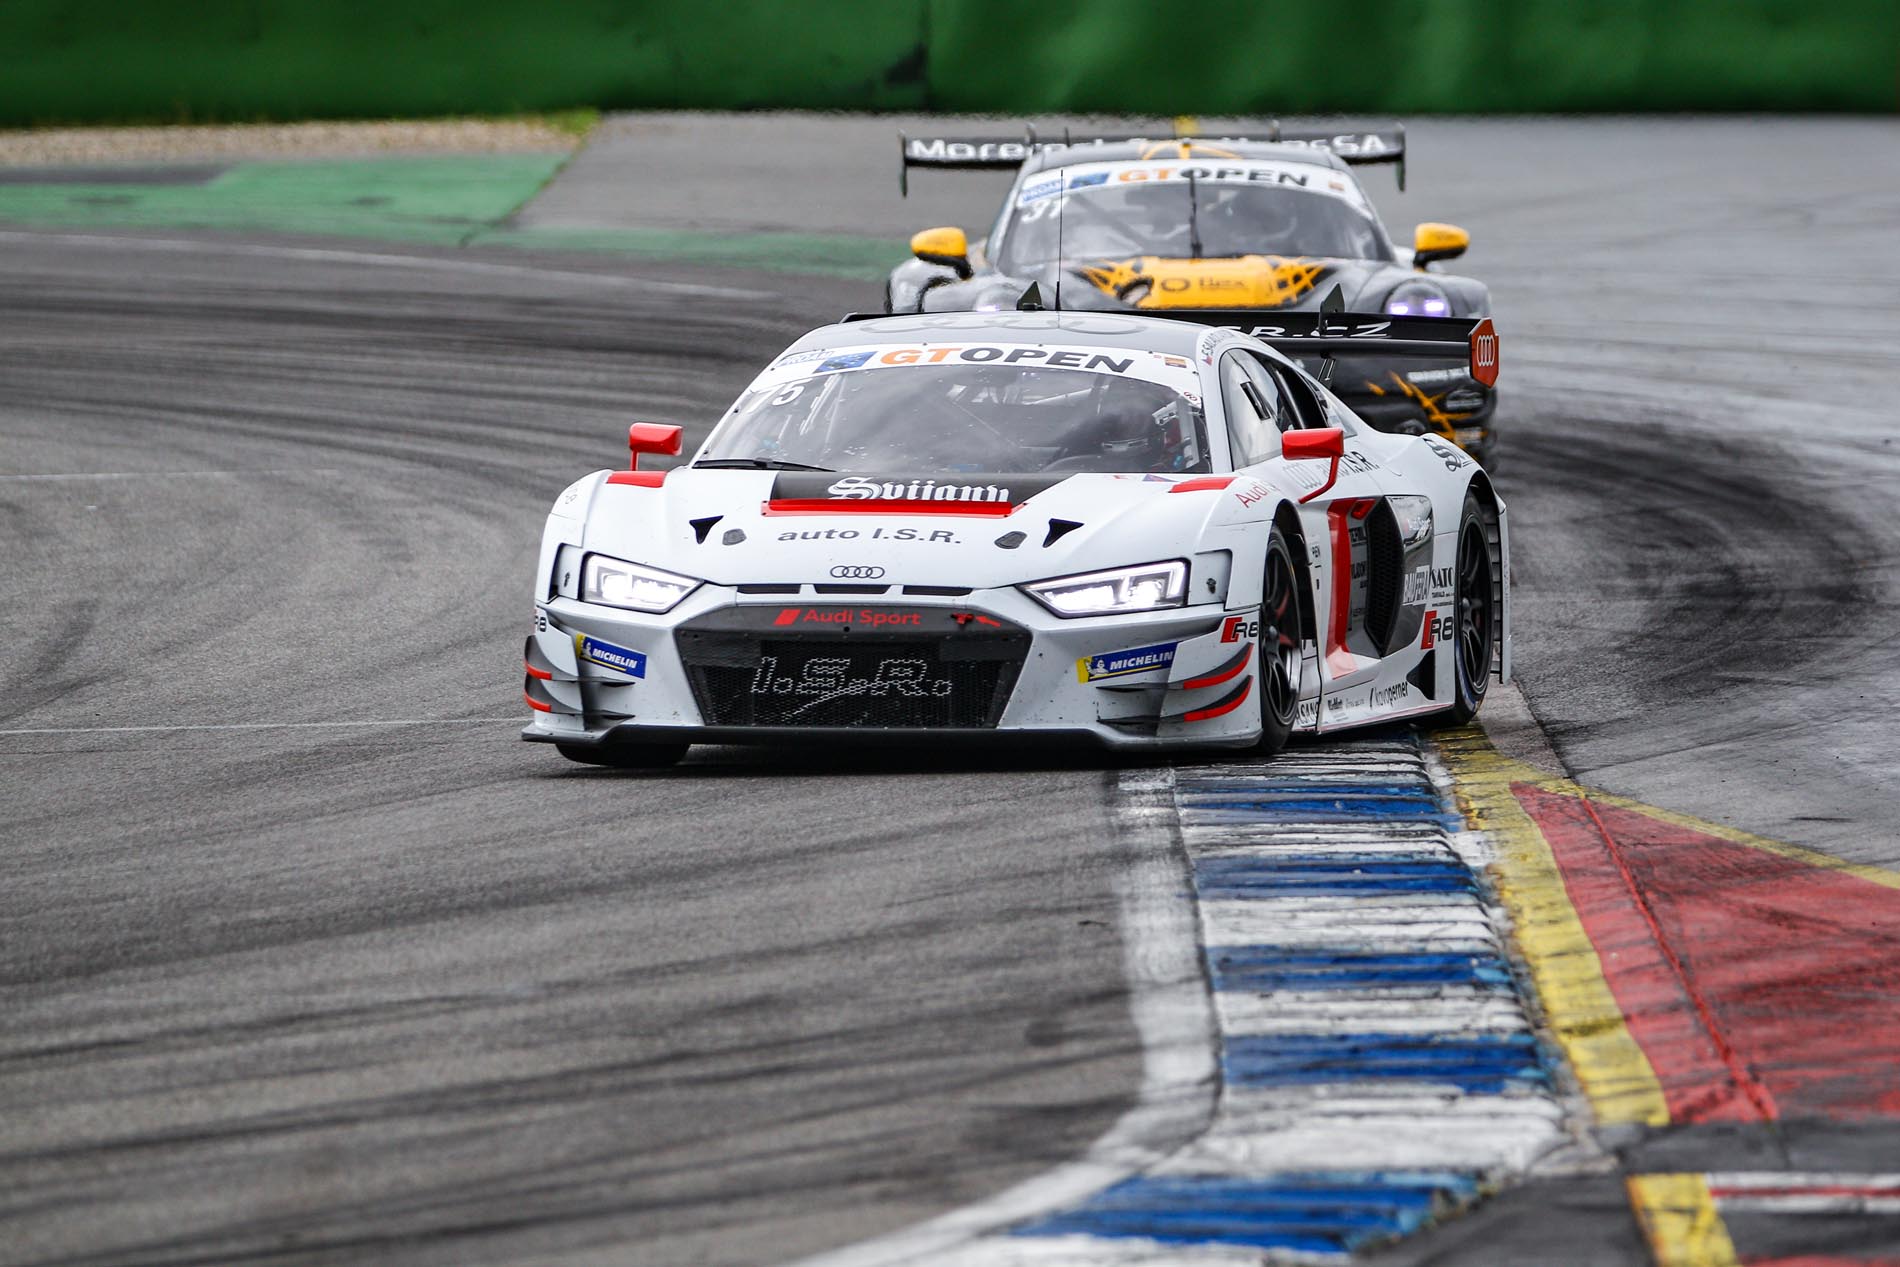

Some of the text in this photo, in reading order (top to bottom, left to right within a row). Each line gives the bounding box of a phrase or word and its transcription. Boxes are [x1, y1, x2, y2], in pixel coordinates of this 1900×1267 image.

[777, 527, 962, 544] auto I.S.R.
[803, 608, 921, 626] Audi Sport
[592, 647, 639, 669] MICHELIN
[1109, 650, 1175, 671] MICHELIN
